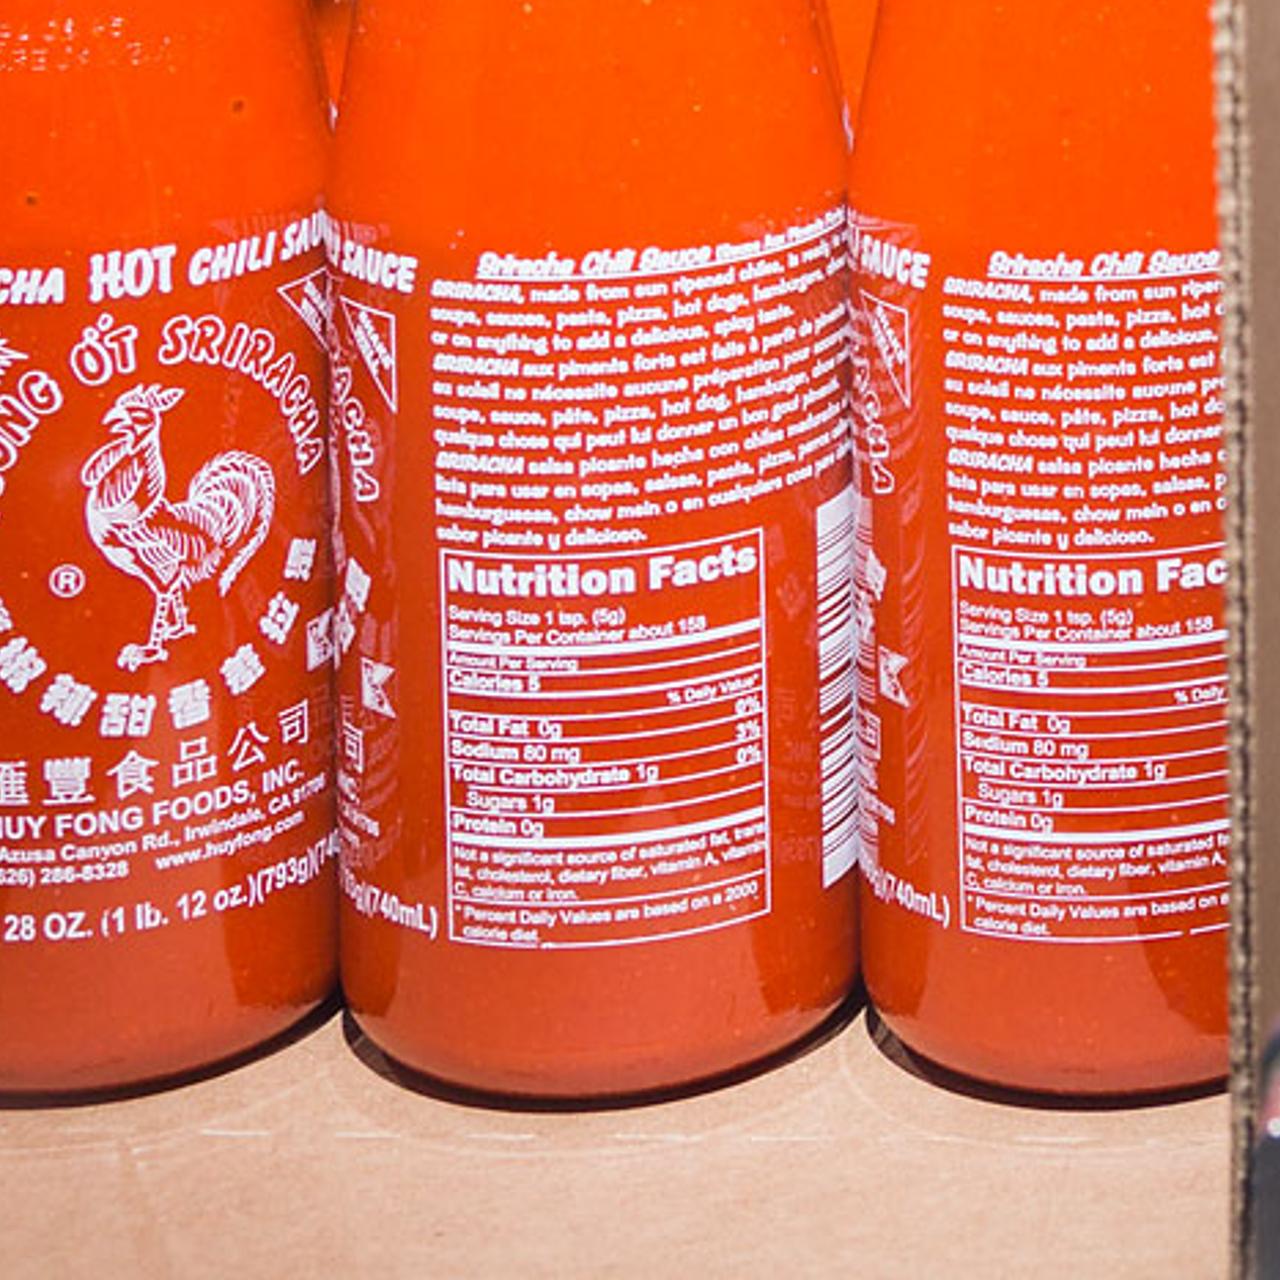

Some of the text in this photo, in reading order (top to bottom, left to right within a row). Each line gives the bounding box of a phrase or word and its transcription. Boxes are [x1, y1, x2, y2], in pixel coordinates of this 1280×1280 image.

[89, 244, 177, 303] HOT
[188, 230, 278, 287] CHILI
[342, 238, 419, 293] SAUCE
[861, 235, 931, 289] SAUCE
[158, 314, 323, 476] SRIRACHA
[447, 545, 757, 597] Nutrition Facts
[958, 555, 1229, 597] Nutrition Fac
[448, 605, 502, 627] Serving
[505, 610, 541, 625] Size
[545, 611, 553, 625] 1
[958, 600, 1013, 624] Serving
[1053, 610, 1063, 624] 1
[448, 624, 512, 645] Servings
[514, 629, 544, 645] Per
[546, 628, 626, 646] Container
[628, 621, 674, 640] about
[958, 615, 1215, 642] Servings Per Container about 158
[500, 655, 524, 670] Per
[527, 656, 579, 671] Serving
[1009, 648, 1033, 664] Per
[1036, 650, 1088, 669] Serving
[449, 670, 541, 692] Calories 5
[960, 662, 1050, 688] Calories 5
[684, 686, 718, 703] Daily
[1192, 684, 1226, 703] Daily
[451, 696, 762, 738] Total Fat 0g 0%
[961, 703, 1072, 735] Total Fat 0g
[451, 739, 519, 762] Sodium
[523, 745, 547, 762] 80
[551, 746, 581, 765] mg
[961, 730, 1090, 759] Sodium 80 mg
[452, 744, 763, 788] Total Carbohydrate 1g 0%
[963, 755, 1168, 786] Total Carbohydrate 1g
[0, 759, 305, 840] UY FONG FOODS, INC.
[466, 791, 555, 814] Sugars 1g
[977, 781, 1064, 809] Sugars 1g
[60, 841, 138, 861] Canyon
[268, 795, 291, 815] CA
[452, 814, 544, 838] Protein 0g
[964, 805, 1054, 833] Protein 0g
[155, 811, 305, 870] www.huyfong.com
[4, 915, 36, 942] 28
[43, 911, 93, 941] OZ.
[101, 906, 126, 938] (1
[135, 900, 168, 931] lb.
[176, 890, 208, 920] 12
